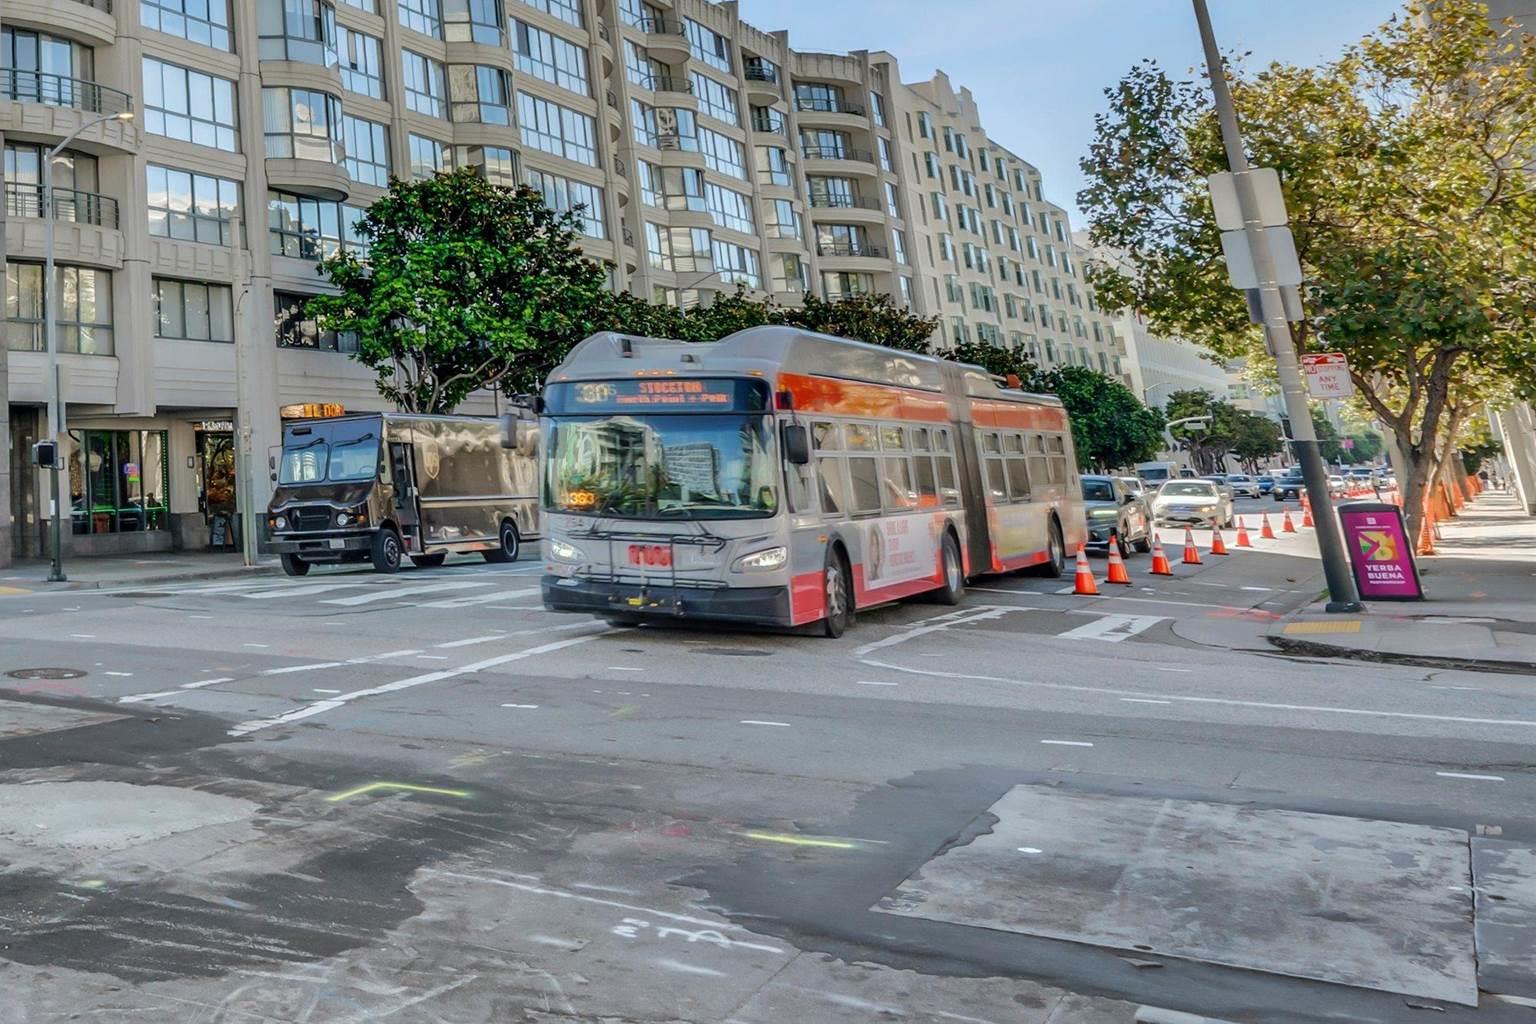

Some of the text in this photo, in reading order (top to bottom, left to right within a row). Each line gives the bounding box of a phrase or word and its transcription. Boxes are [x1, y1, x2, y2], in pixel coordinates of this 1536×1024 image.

[1320, 383, 1340, 391] TIME
[1365, 564, 1402, 572] YERBA
[1368, 572, 1405, 580] BUENA
